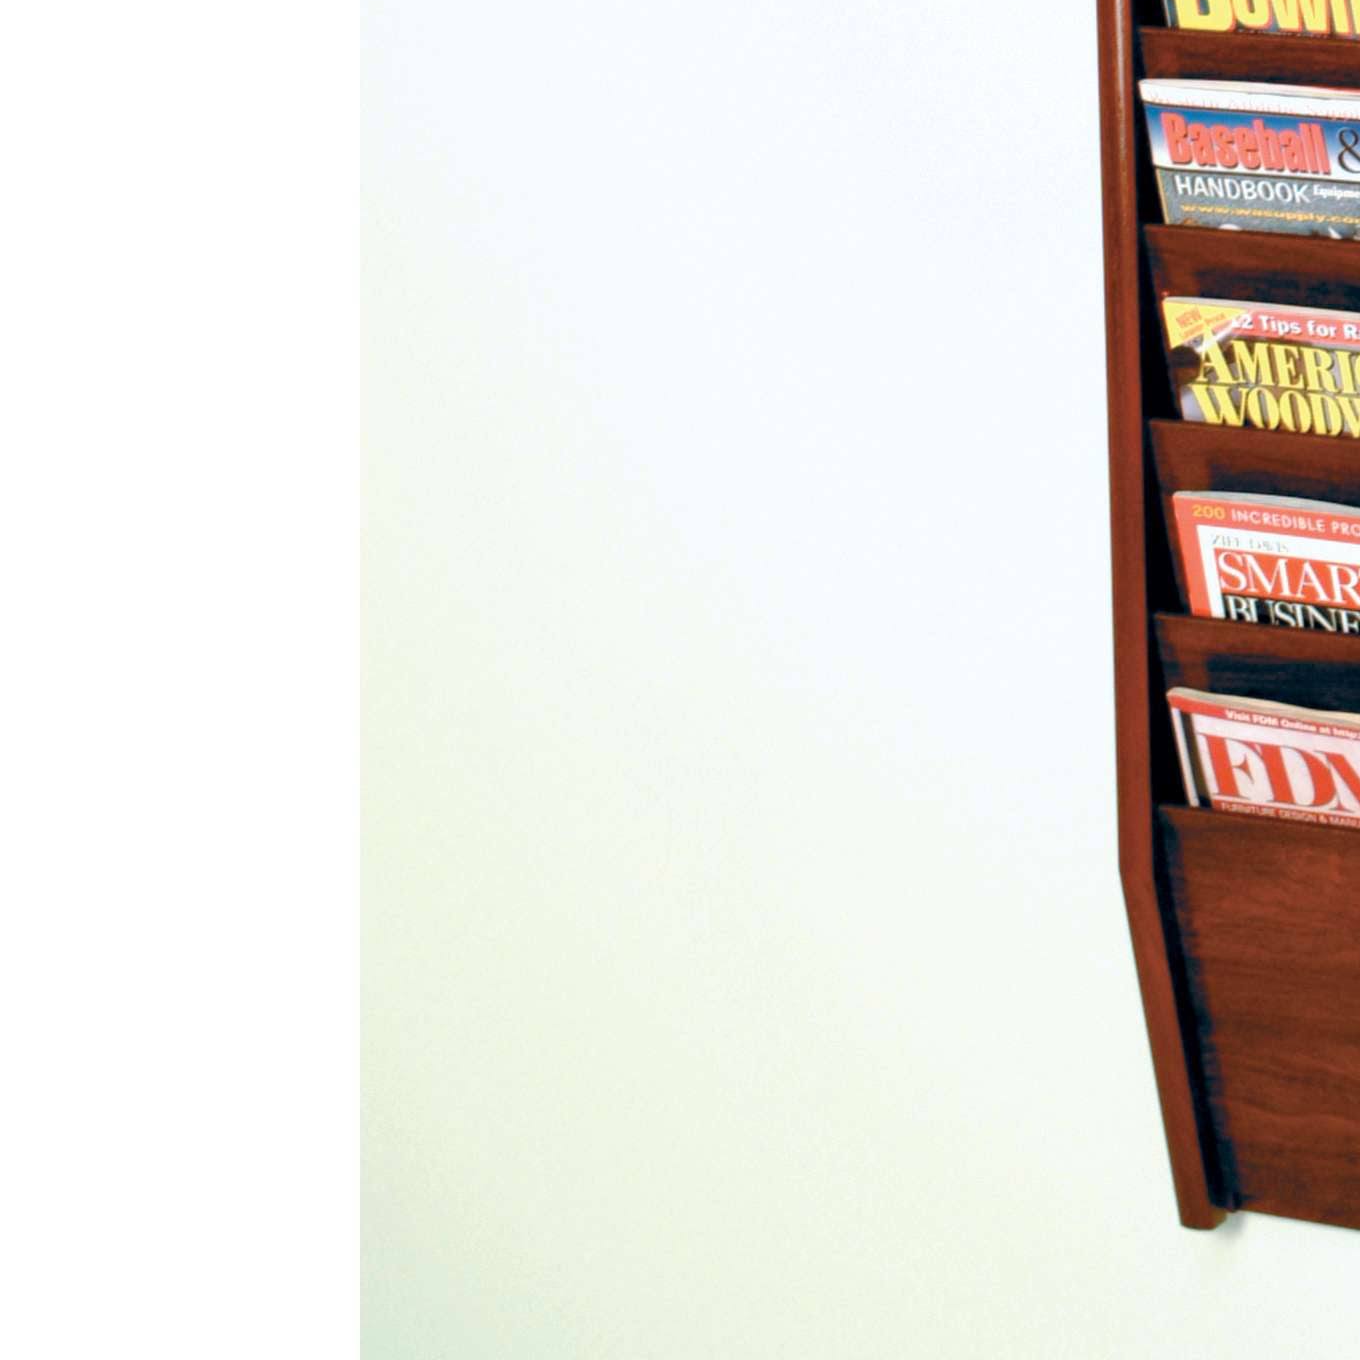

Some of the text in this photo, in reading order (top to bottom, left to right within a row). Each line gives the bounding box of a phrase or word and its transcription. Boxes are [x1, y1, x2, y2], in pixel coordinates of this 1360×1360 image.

[1161, 111, 1332, 176] Baseball
[1174, 174, 1312, 204] HANDBOOK
[1258, 315, 1301, 337] Tips
[1306, 320, 1337, 338] for
[1192, 504, 1226, 520] 200
[1231, 508, 1326, 534] INCREDIBLE
[1224, 708, 1250, 721] Visit
[1252, 713, 1279, 726] FDM
[1281, 718, 1317, 732] Online
[1319, 723, 1331, 734] at
[1221, 801, 1277, 817] FURNITURE
[1279, 808, 1317, 823] DESIGN
